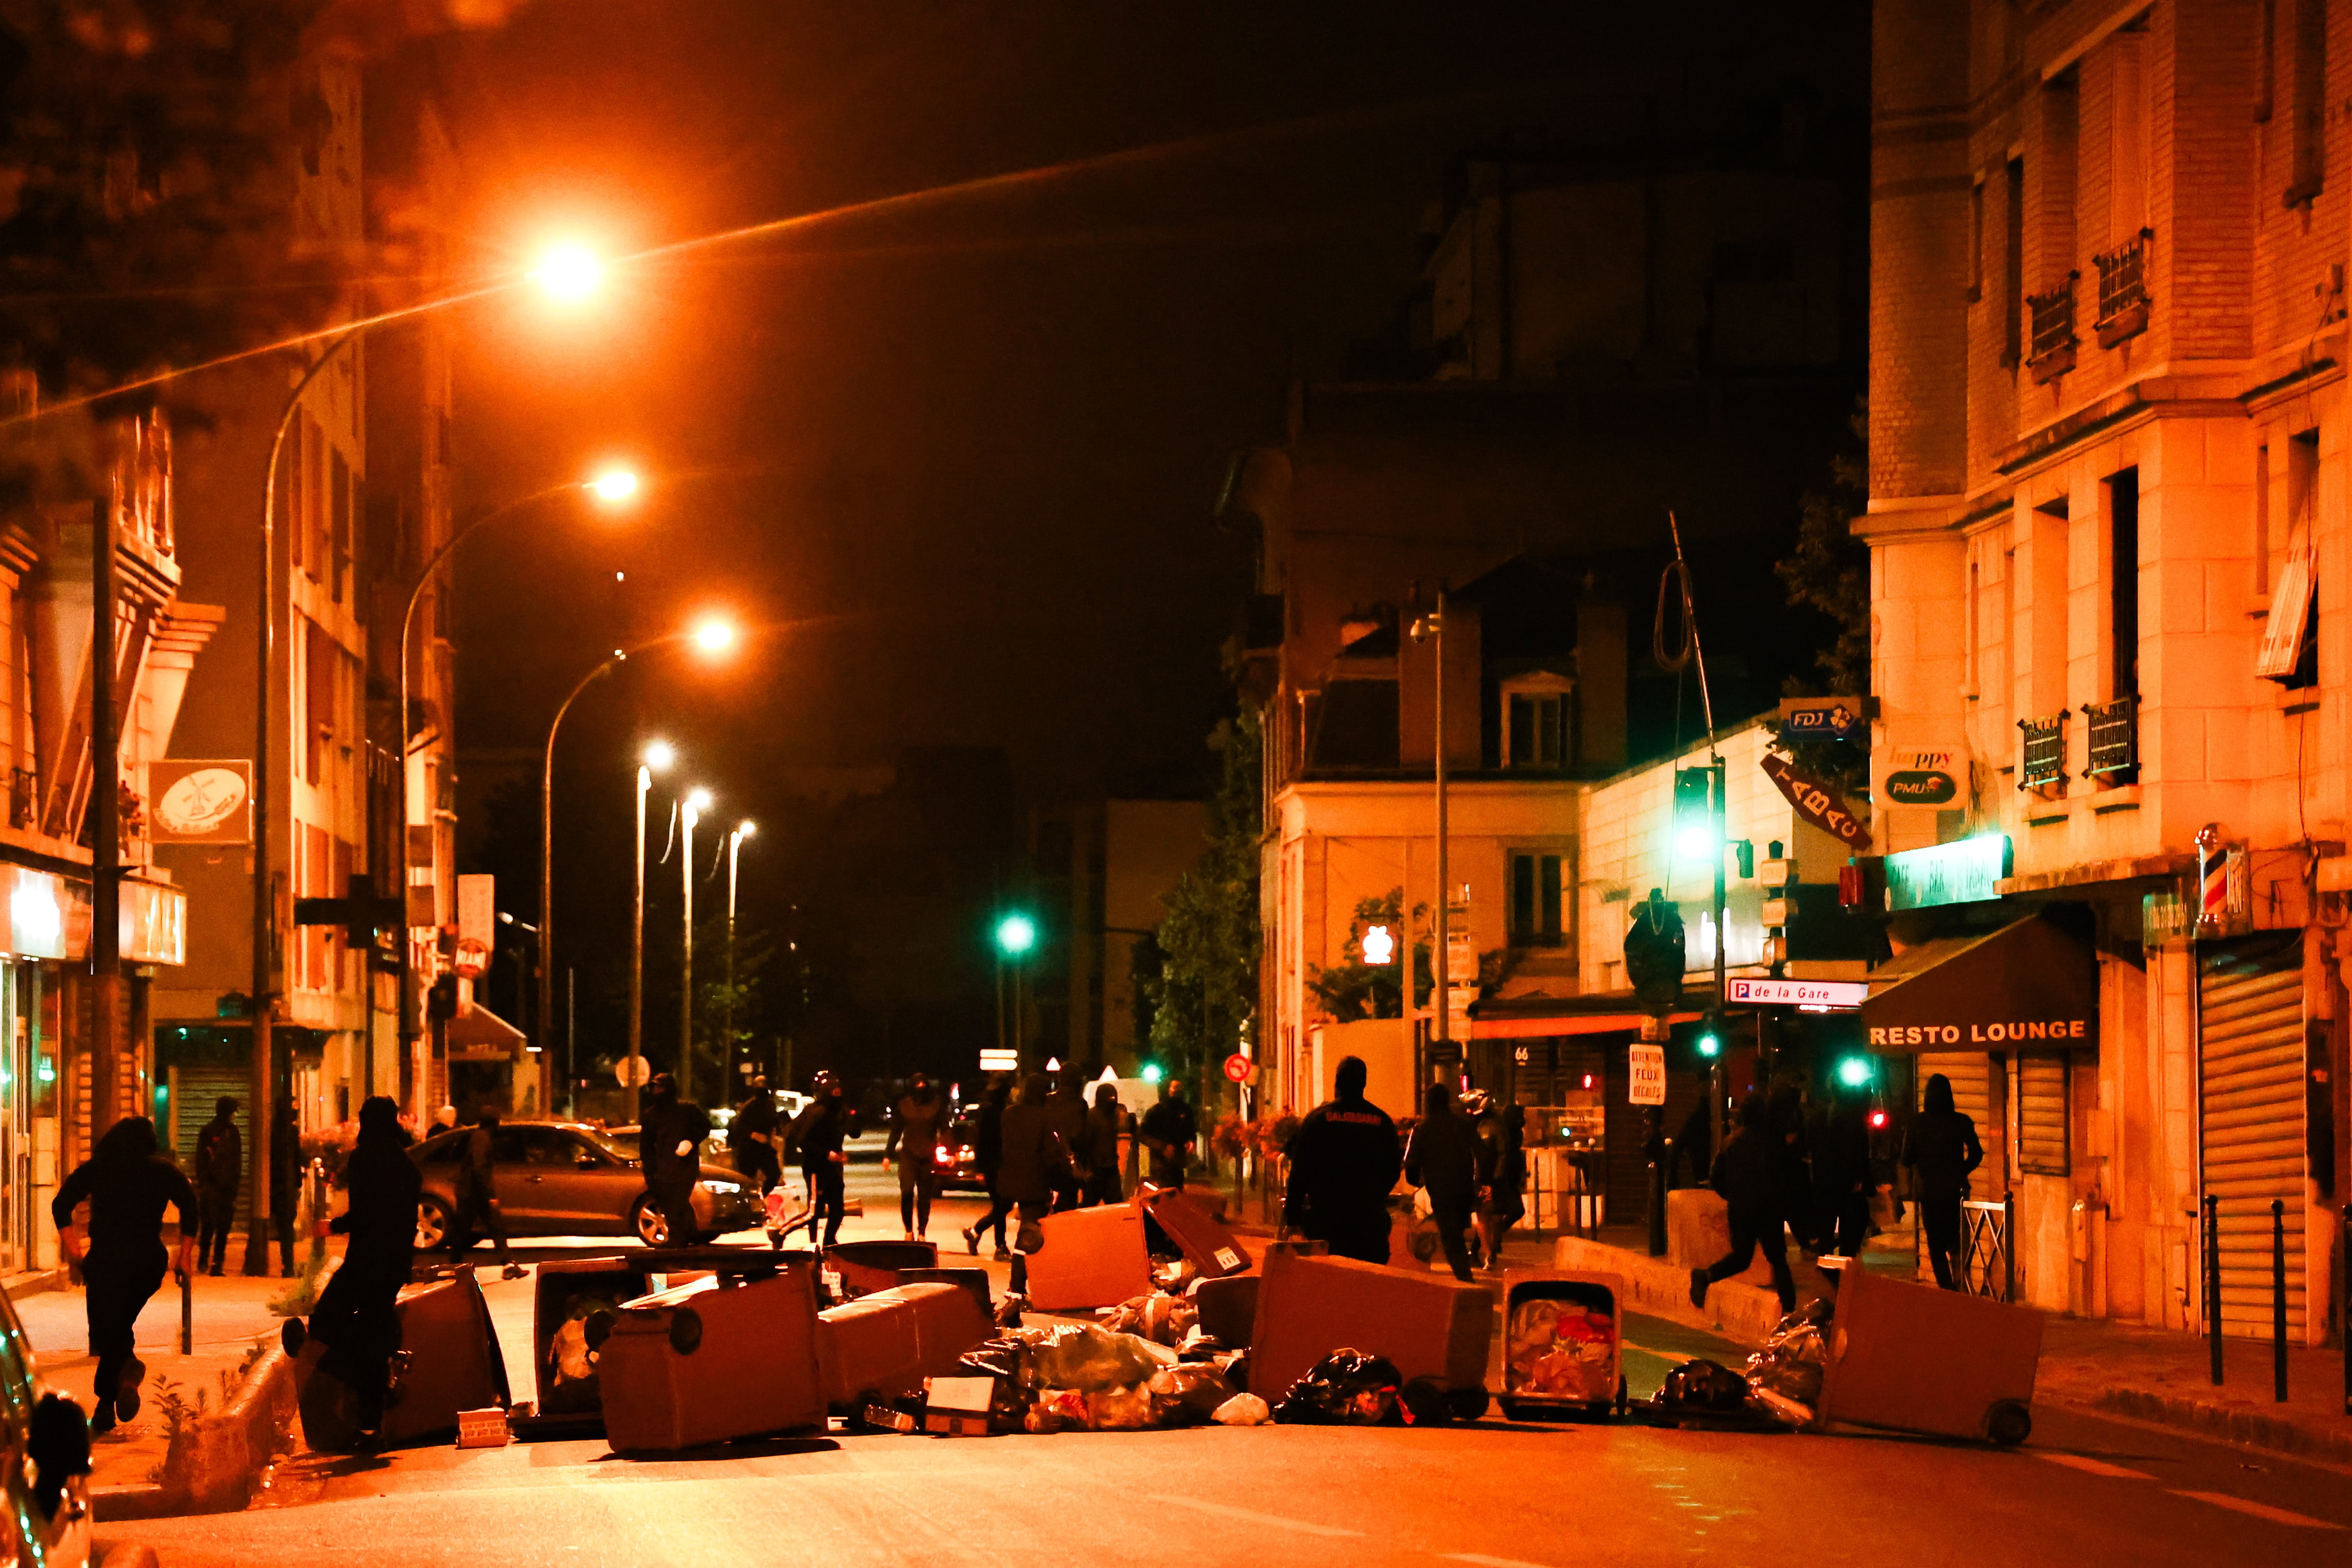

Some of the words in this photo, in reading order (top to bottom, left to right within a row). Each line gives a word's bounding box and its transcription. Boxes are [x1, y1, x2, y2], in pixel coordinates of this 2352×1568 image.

[1793, 712, 1824, 726] FDJ
[1893, 782, 1925, 794] PMU
[1776, 767, 1857, 837] TABAC
[1929, 858, 1944, 893] BAR
[1738, 984, 1747, 997] P
[1755, 986, 1770, 997] de
[1778, 986, 1789, 998] la
[1798, 987, 1829, 999] Gare
[1870, 1025, 1960, 1045] RESTO
[1971, 1021, 2085, 1042] LOUNGE
[1515, 1047, 1528, 1060] 66
[1636, 1068, 1659, 1081] FEUX
